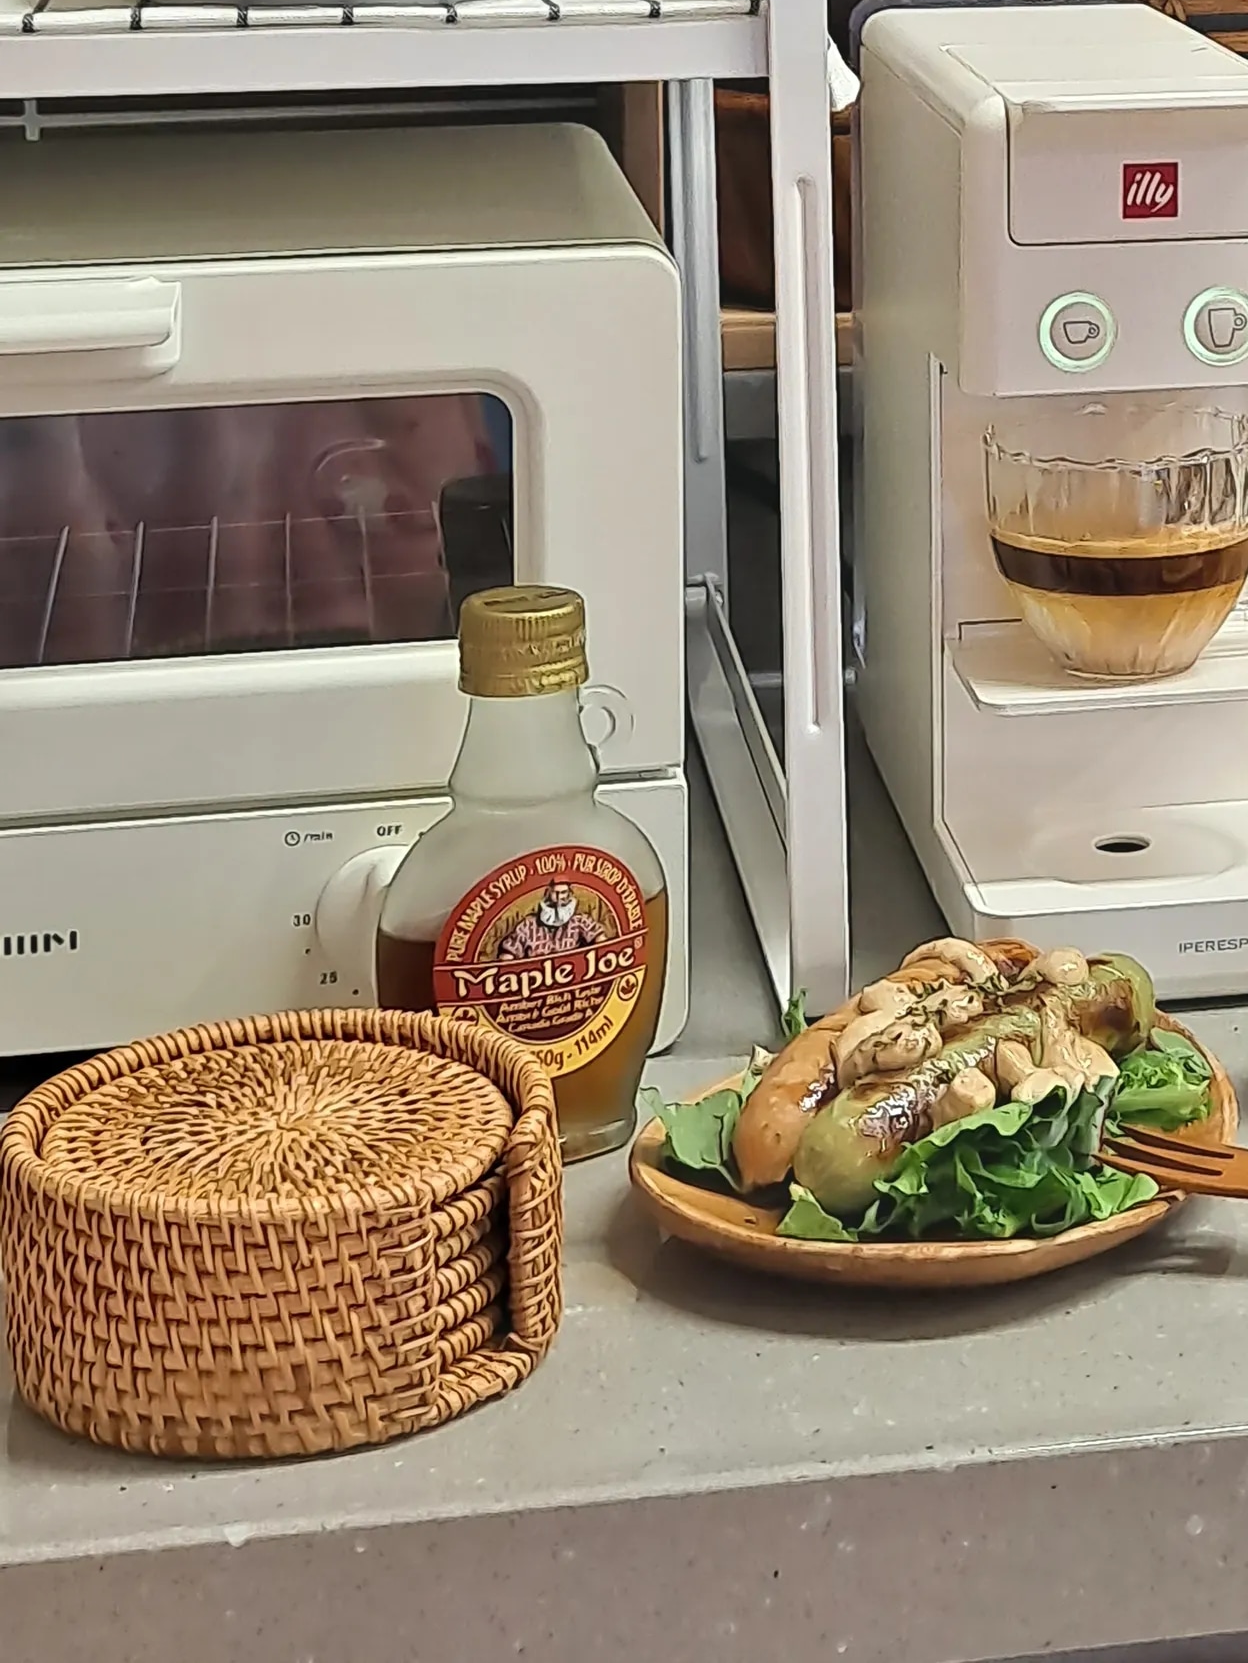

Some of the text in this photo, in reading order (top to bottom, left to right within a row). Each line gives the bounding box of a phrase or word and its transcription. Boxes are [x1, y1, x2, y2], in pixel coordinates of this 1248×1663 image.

[1126, 172, 1177, 213] illy
[376, 824, 402, 837] OFF
[572, 852, 597, 874] PUR
[488, 864, 527, 899] SYRUP
[292, 913, 312, 928] 30
[456, 889, 497, 934] MAPLE
[446, 927, 470, 963] PURE
[319, 970, 339, 985] 25
[454, 946, 636, 998] Maple Joe
[574, 1015, 614, 1056] 114ml
